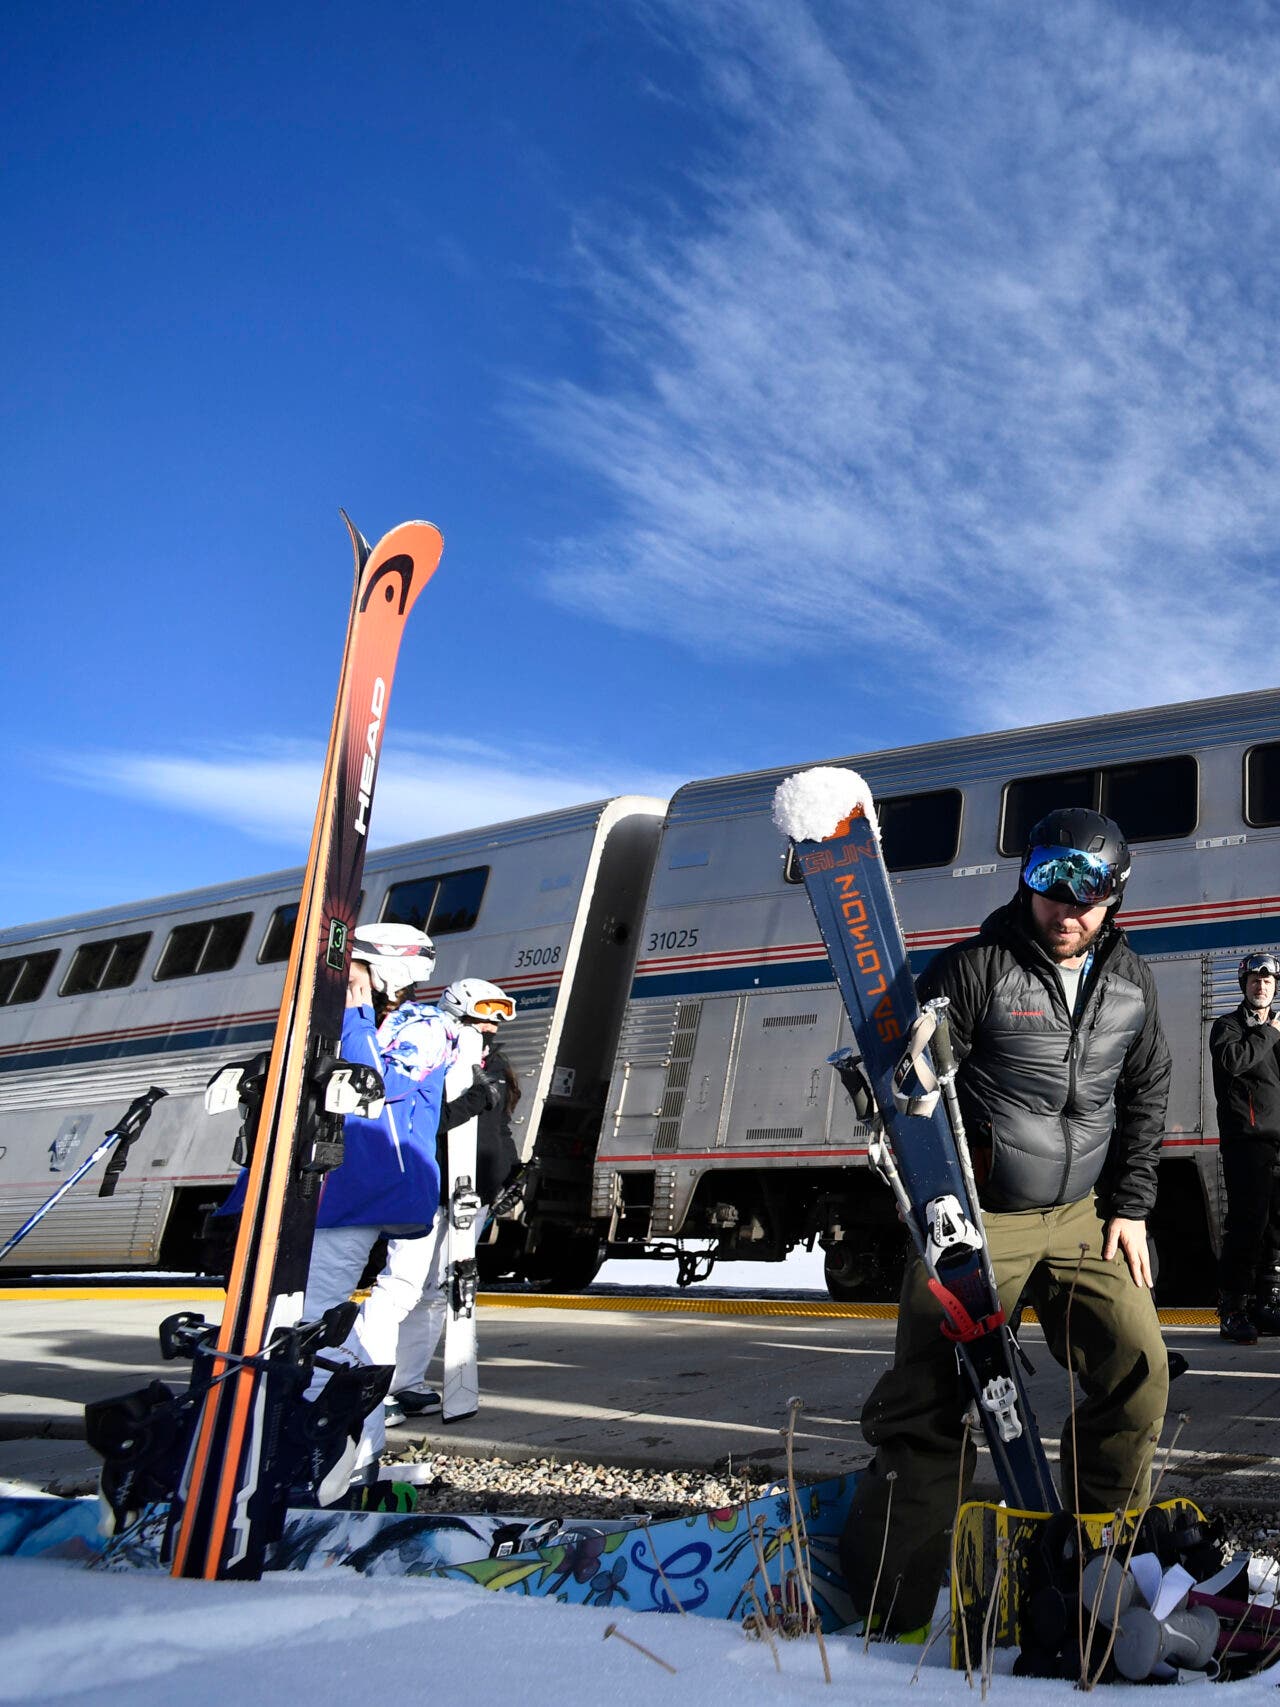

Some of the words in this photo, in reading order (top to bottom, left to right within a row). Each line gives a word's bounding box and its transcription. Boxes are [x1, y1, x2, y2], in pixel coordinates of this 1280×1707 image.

[354, 677, 385, 836] HEAD
[514, 946, 562, 968] 35008
[647, 929, 699, 952] 31025
[834, 873, 902, 1043] SALOMON
